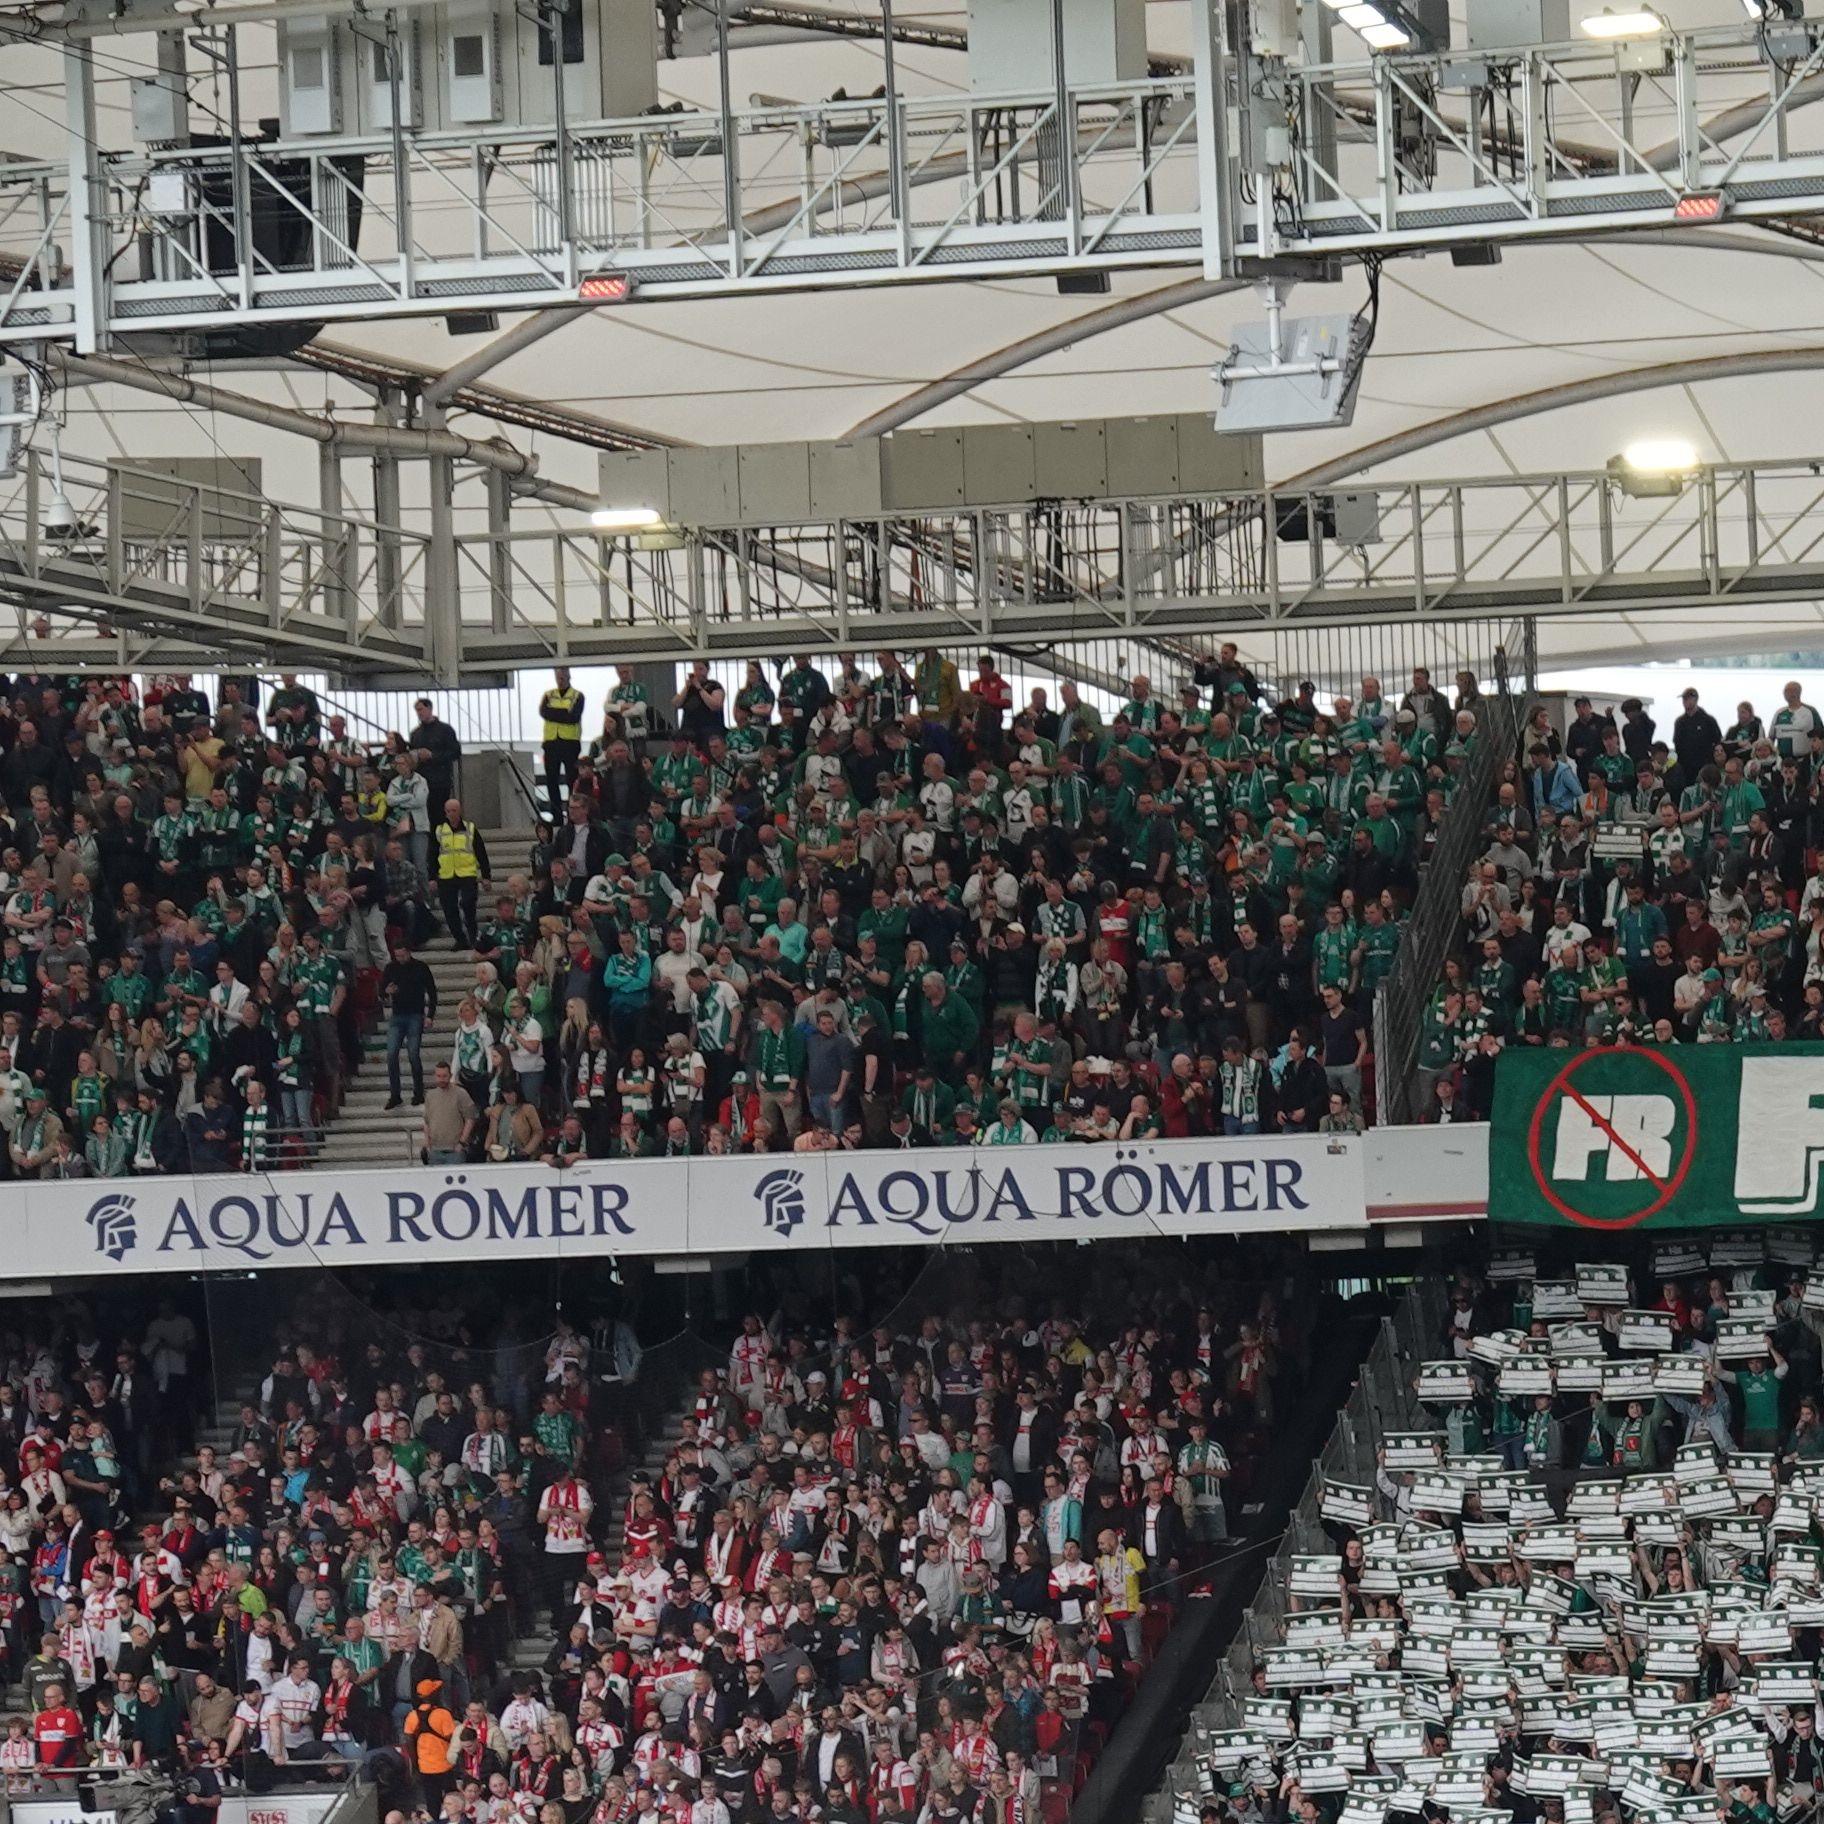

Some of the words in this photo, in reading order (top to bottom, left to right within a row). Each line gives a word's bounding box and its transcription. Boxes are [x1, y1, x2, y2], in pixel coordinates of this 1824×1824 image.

[156, 1195, 361, 1261] AQUA
[386, 1175, 635, 1247] RÖMER
[824, 1169, 1031, 1232] AQUA
[1059, 1149, 1310, 1220] RÖMER
